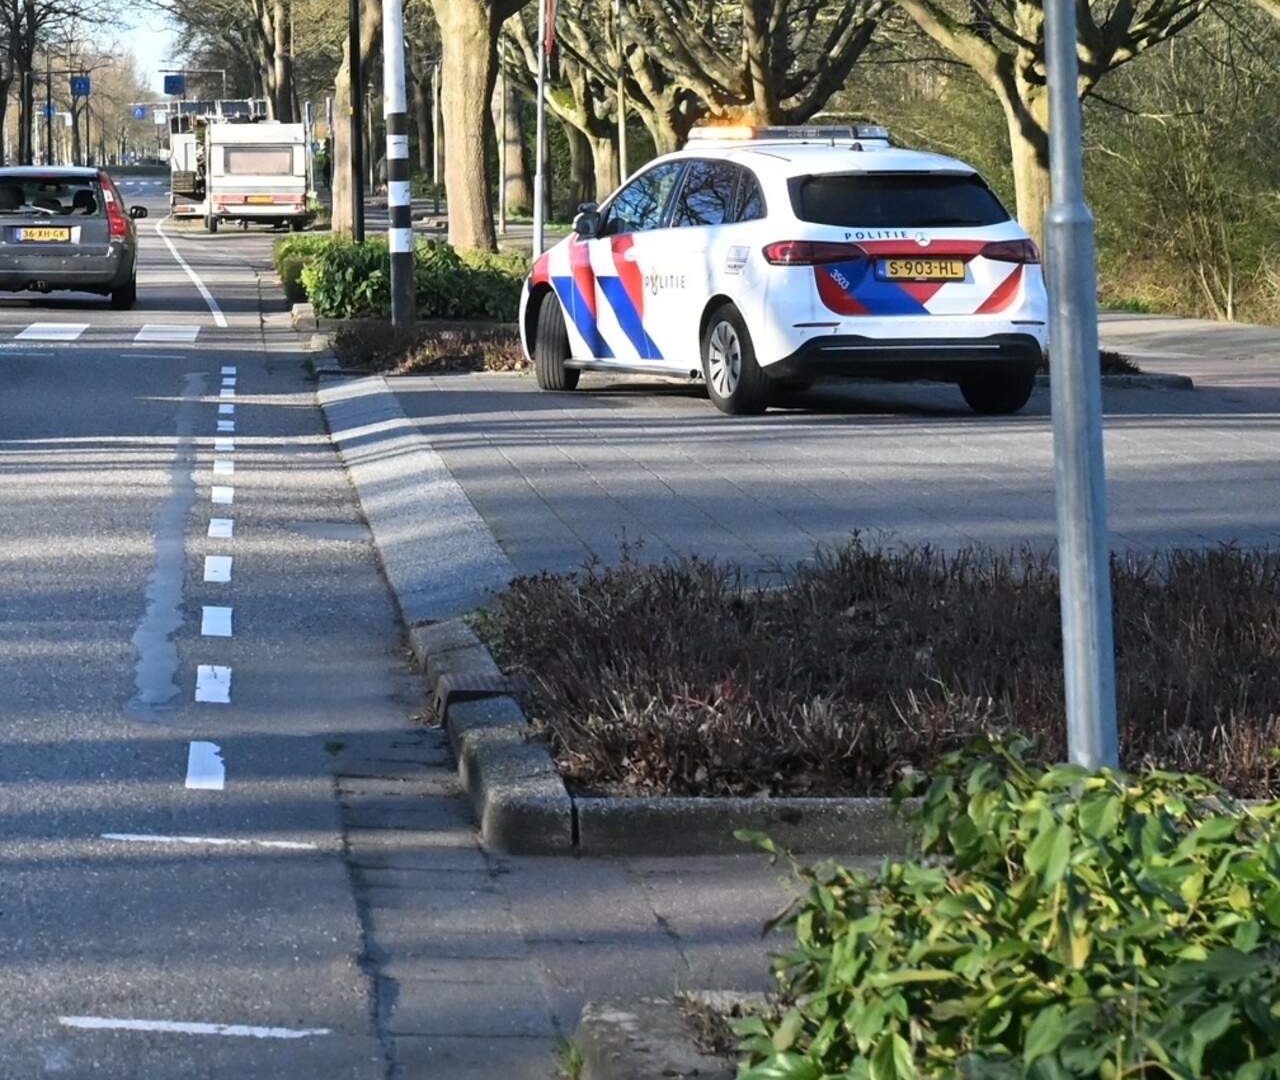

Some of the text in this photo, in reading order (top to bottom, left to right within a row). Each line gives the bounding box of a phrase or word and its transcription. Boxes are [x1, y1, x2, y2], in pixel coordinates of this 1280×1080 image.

[844, 231, 909, 241] POLITIE
[890, 261, 958, 276] S-903-HL
[830, 269, 850, 290] 3503
